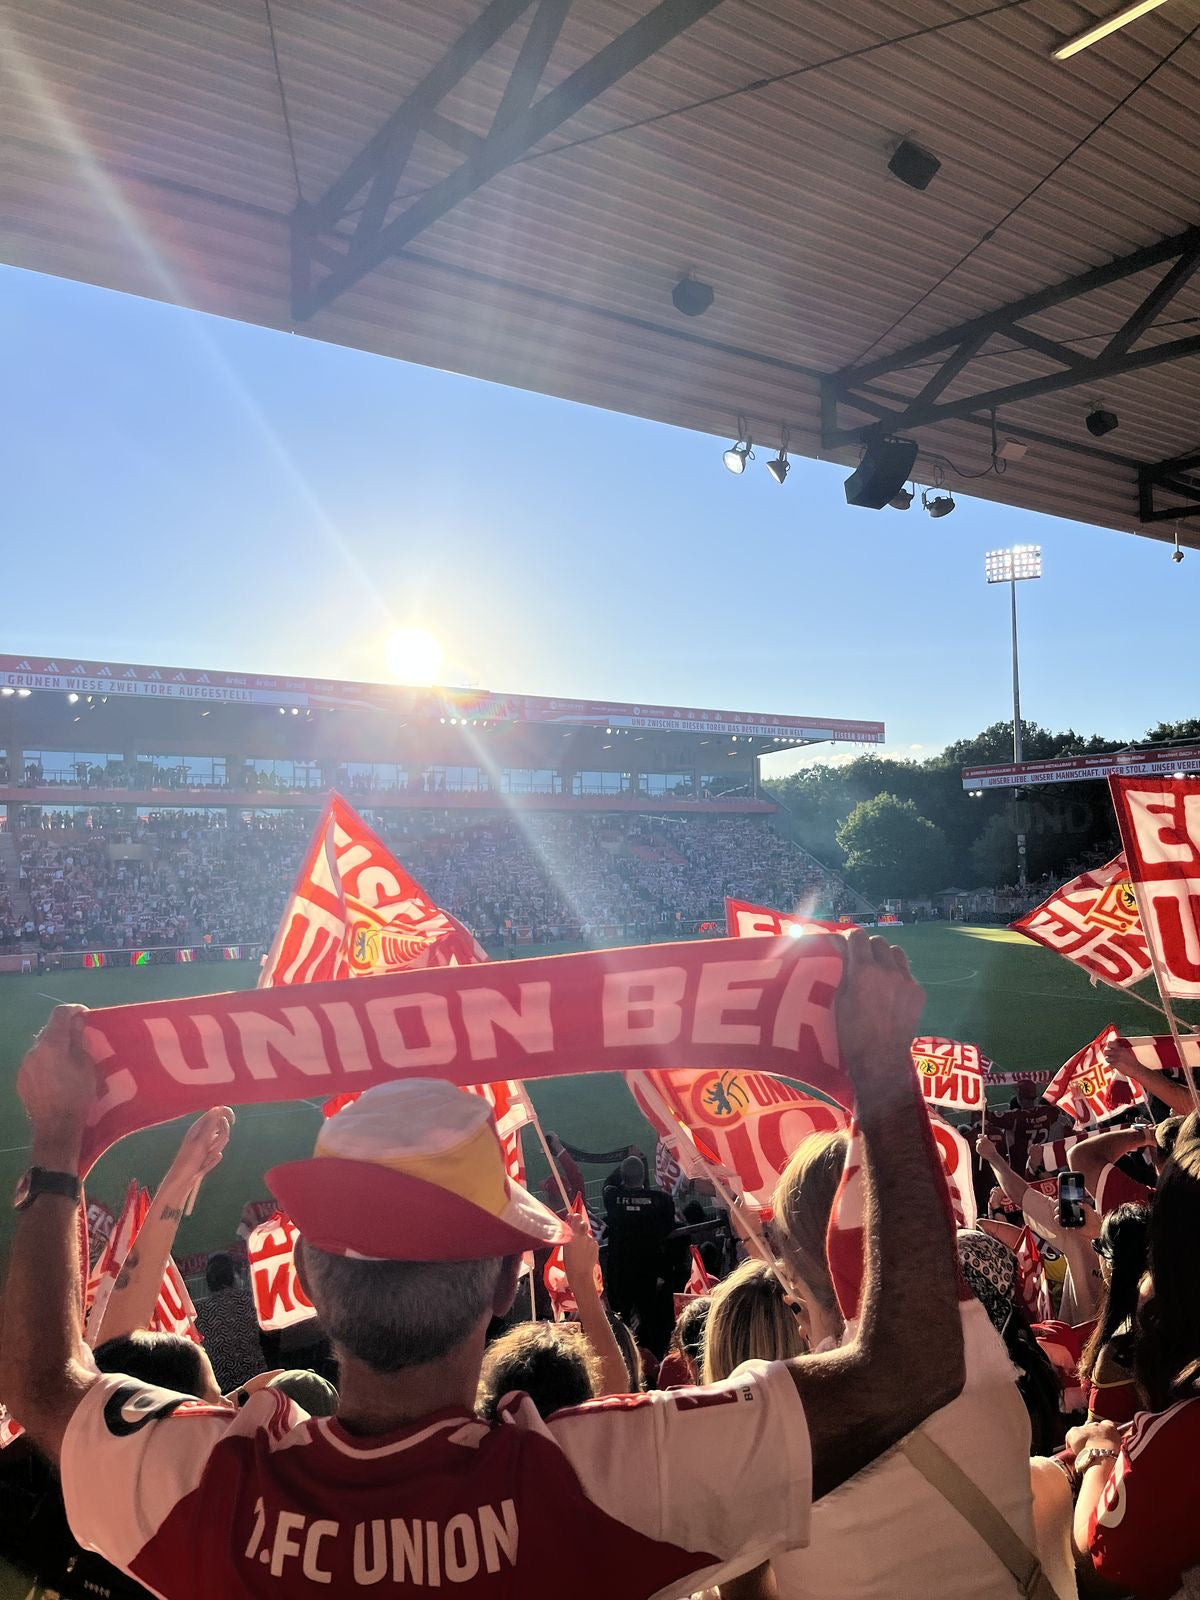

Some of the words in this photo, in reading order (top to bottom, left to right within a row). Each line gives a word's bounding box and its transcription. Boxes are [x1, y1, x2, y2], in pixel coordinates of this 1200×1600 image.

[66, 679, 103, 690] WIESE
[109, 681, 137, 693] ZWEI
[179, 686, 253, 700] AUFGESTELLT
[988, 776, 1011, 785] UNSERE
[1031, 773, 1054, 782] UNSERE
[1056, 768, 1100, 780] MANNSCHAFT.
[1152, 762, 1175, 772] UNSER
[143, 980, 554, 1086] UNION
[353, 1498, 519, 1588] UNION
